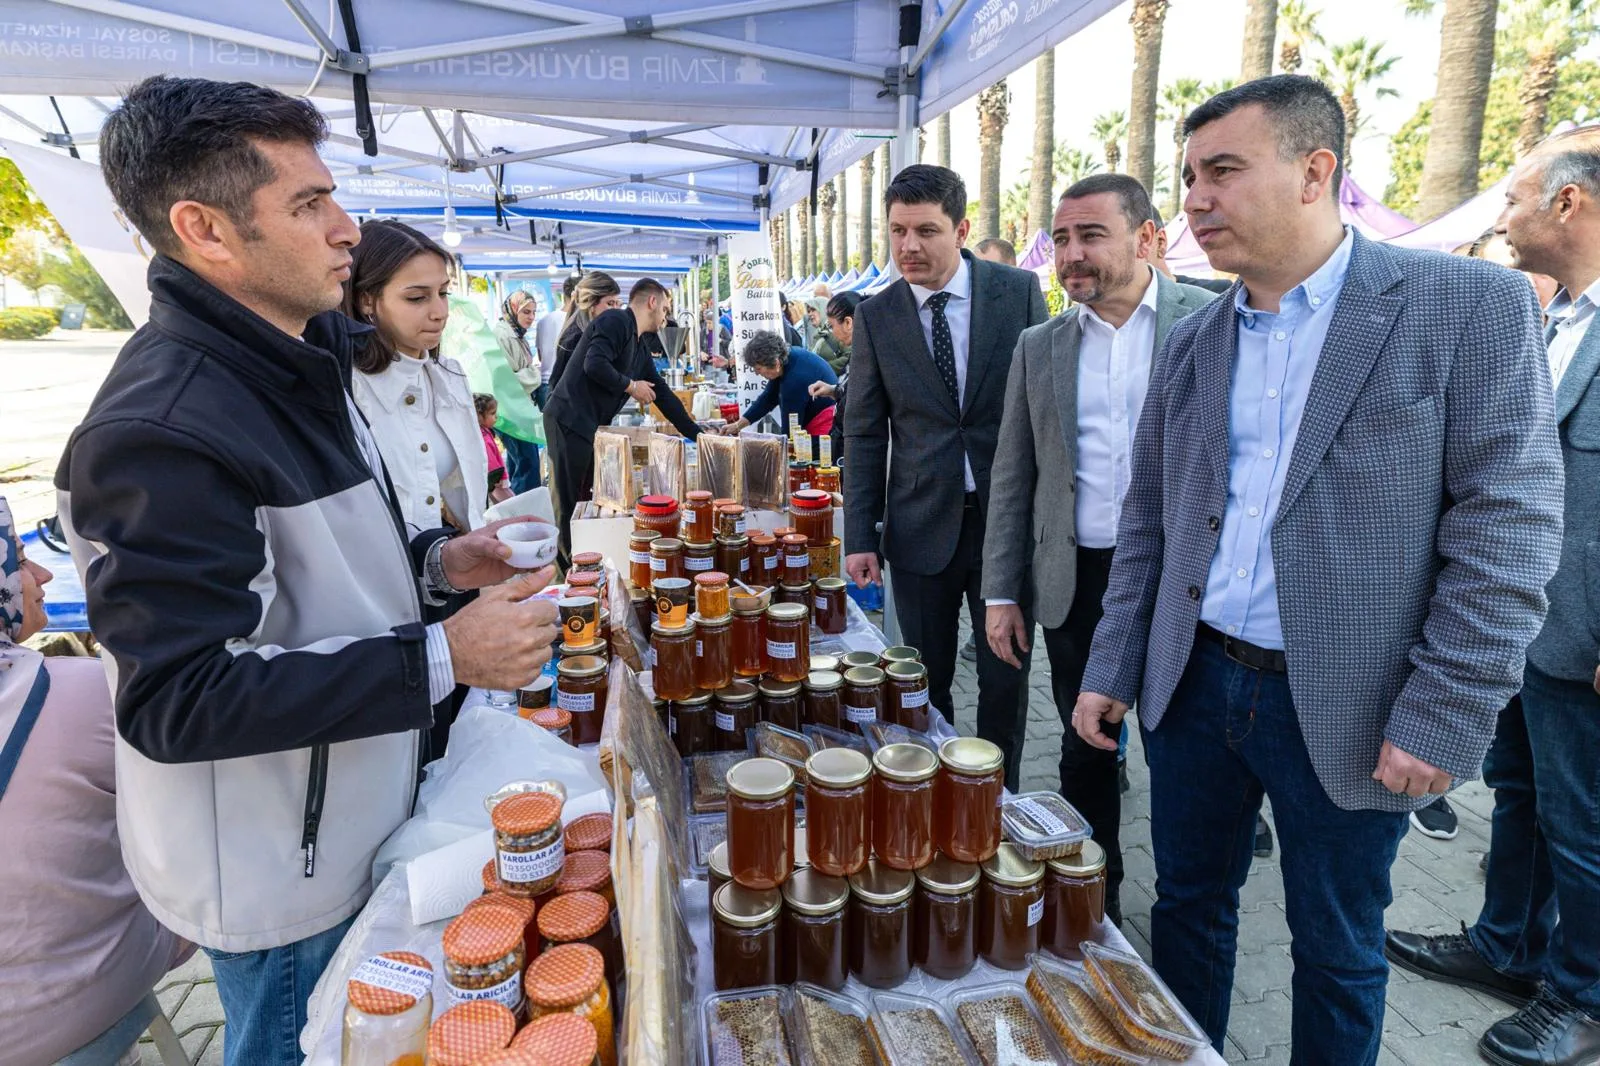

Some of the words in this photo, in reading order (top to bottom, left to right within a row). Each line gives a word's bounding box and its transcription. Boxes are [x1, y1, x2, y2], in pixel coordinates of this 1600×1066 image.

[502, 851, 547, 864] VAROLLAR
[529, 869, 544, 879] 533
[409, 969, 433, 981] ARIC
[475, 978, 518, 1000] ARICILIK
